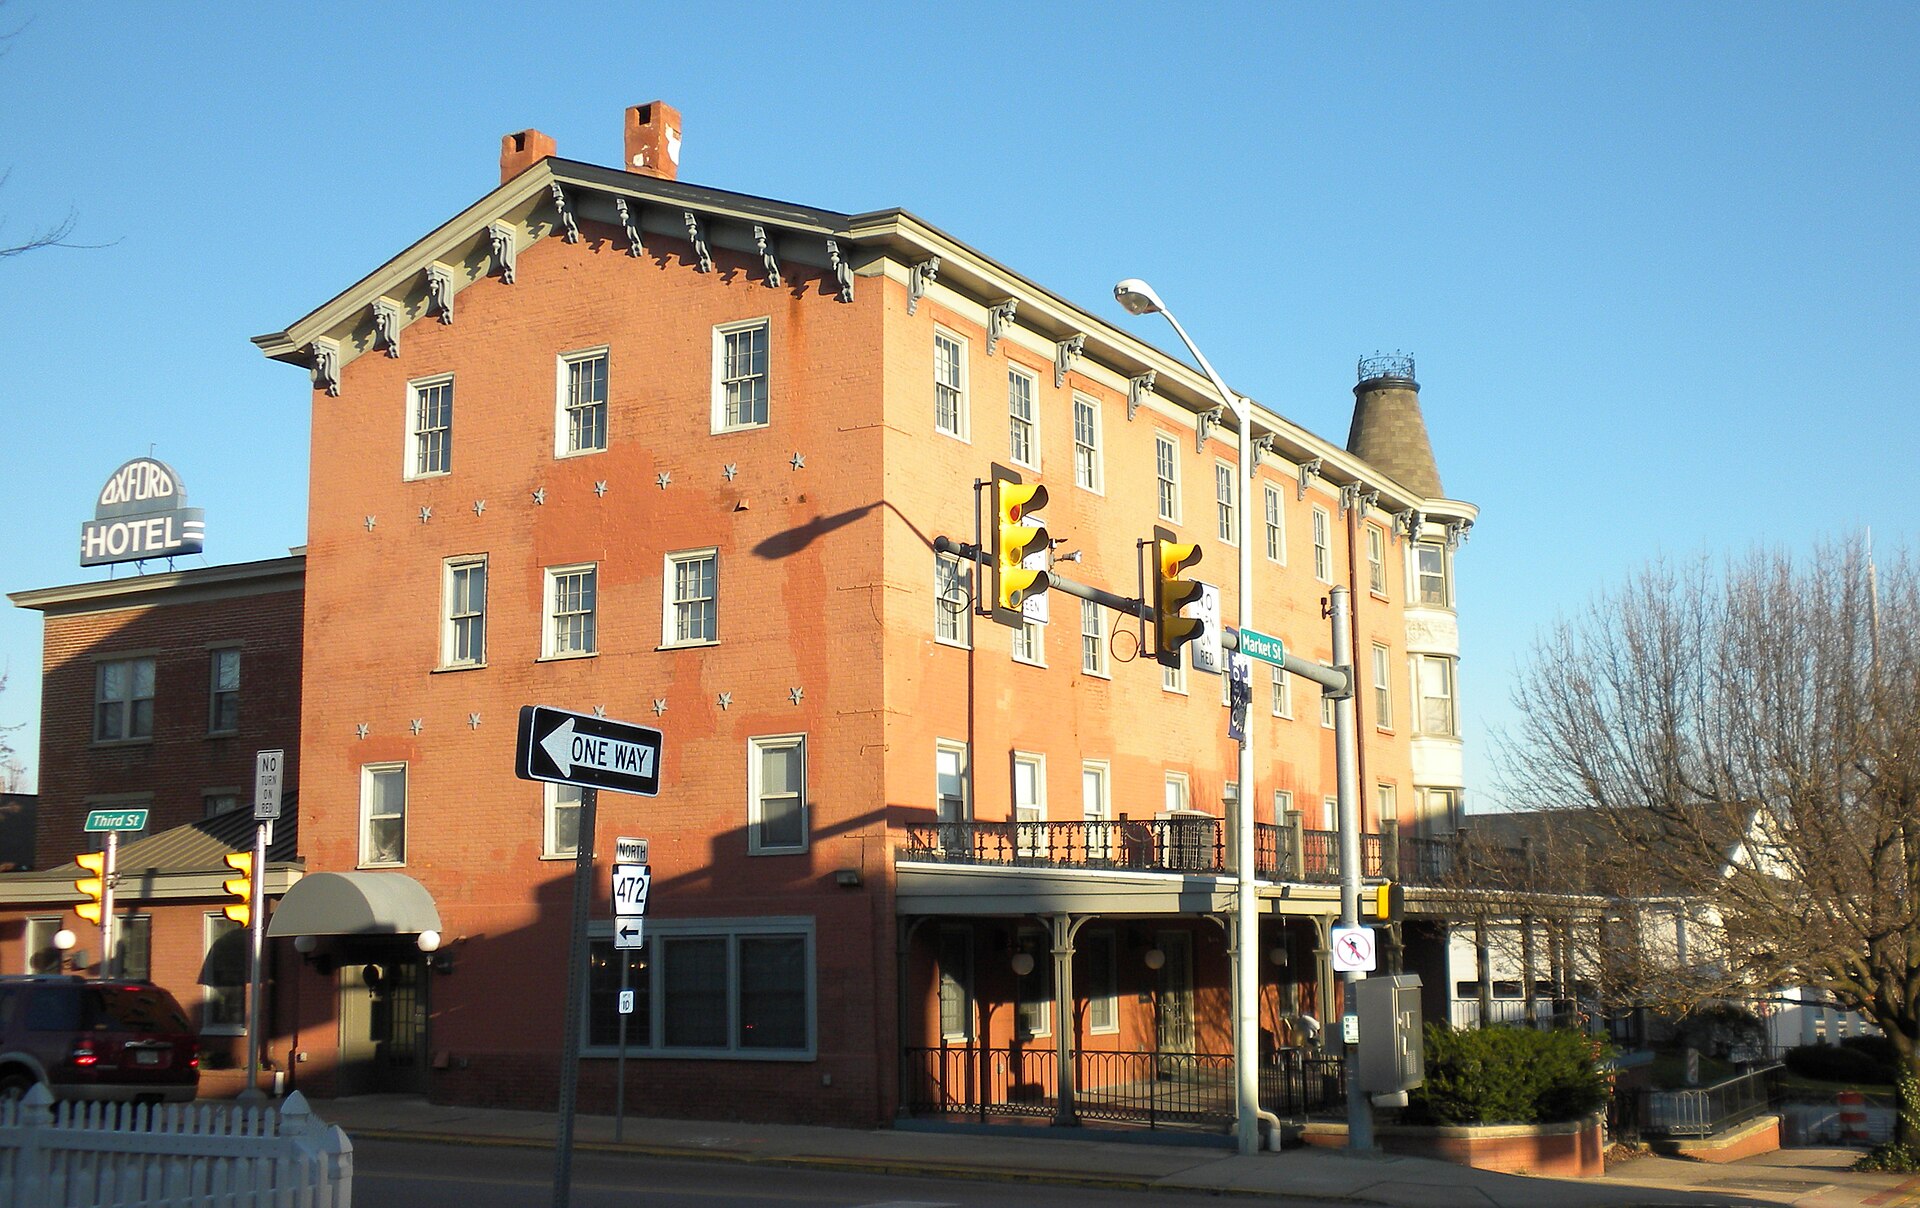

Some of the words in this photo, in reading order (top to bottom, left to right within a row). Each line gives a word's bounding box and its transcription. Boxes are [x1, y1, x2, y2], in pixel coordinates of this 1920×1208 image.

[101, 461, 174, 505] OXFORD
[86, 516, 182, 558] HOTEL
[1242, 632, 1272, 658] Market
[1271, 642, 1282, 661] St
[1200, 649, 1214, 666] RED
[572, 736, 609, 767] ONE
[614, 743, 648, 773] WAY
[262, 757, 277, 772] NO
[261, 774, 277, 786] TURN
[263, 788, 273, 800] ON
[261, 802, 274, 814] RED
[94, 814, 125, 827] Third
[125, 814, 140, 827] St
[619, 842, 646, 859] NORTH
[617, 877, 645, 903] 472
